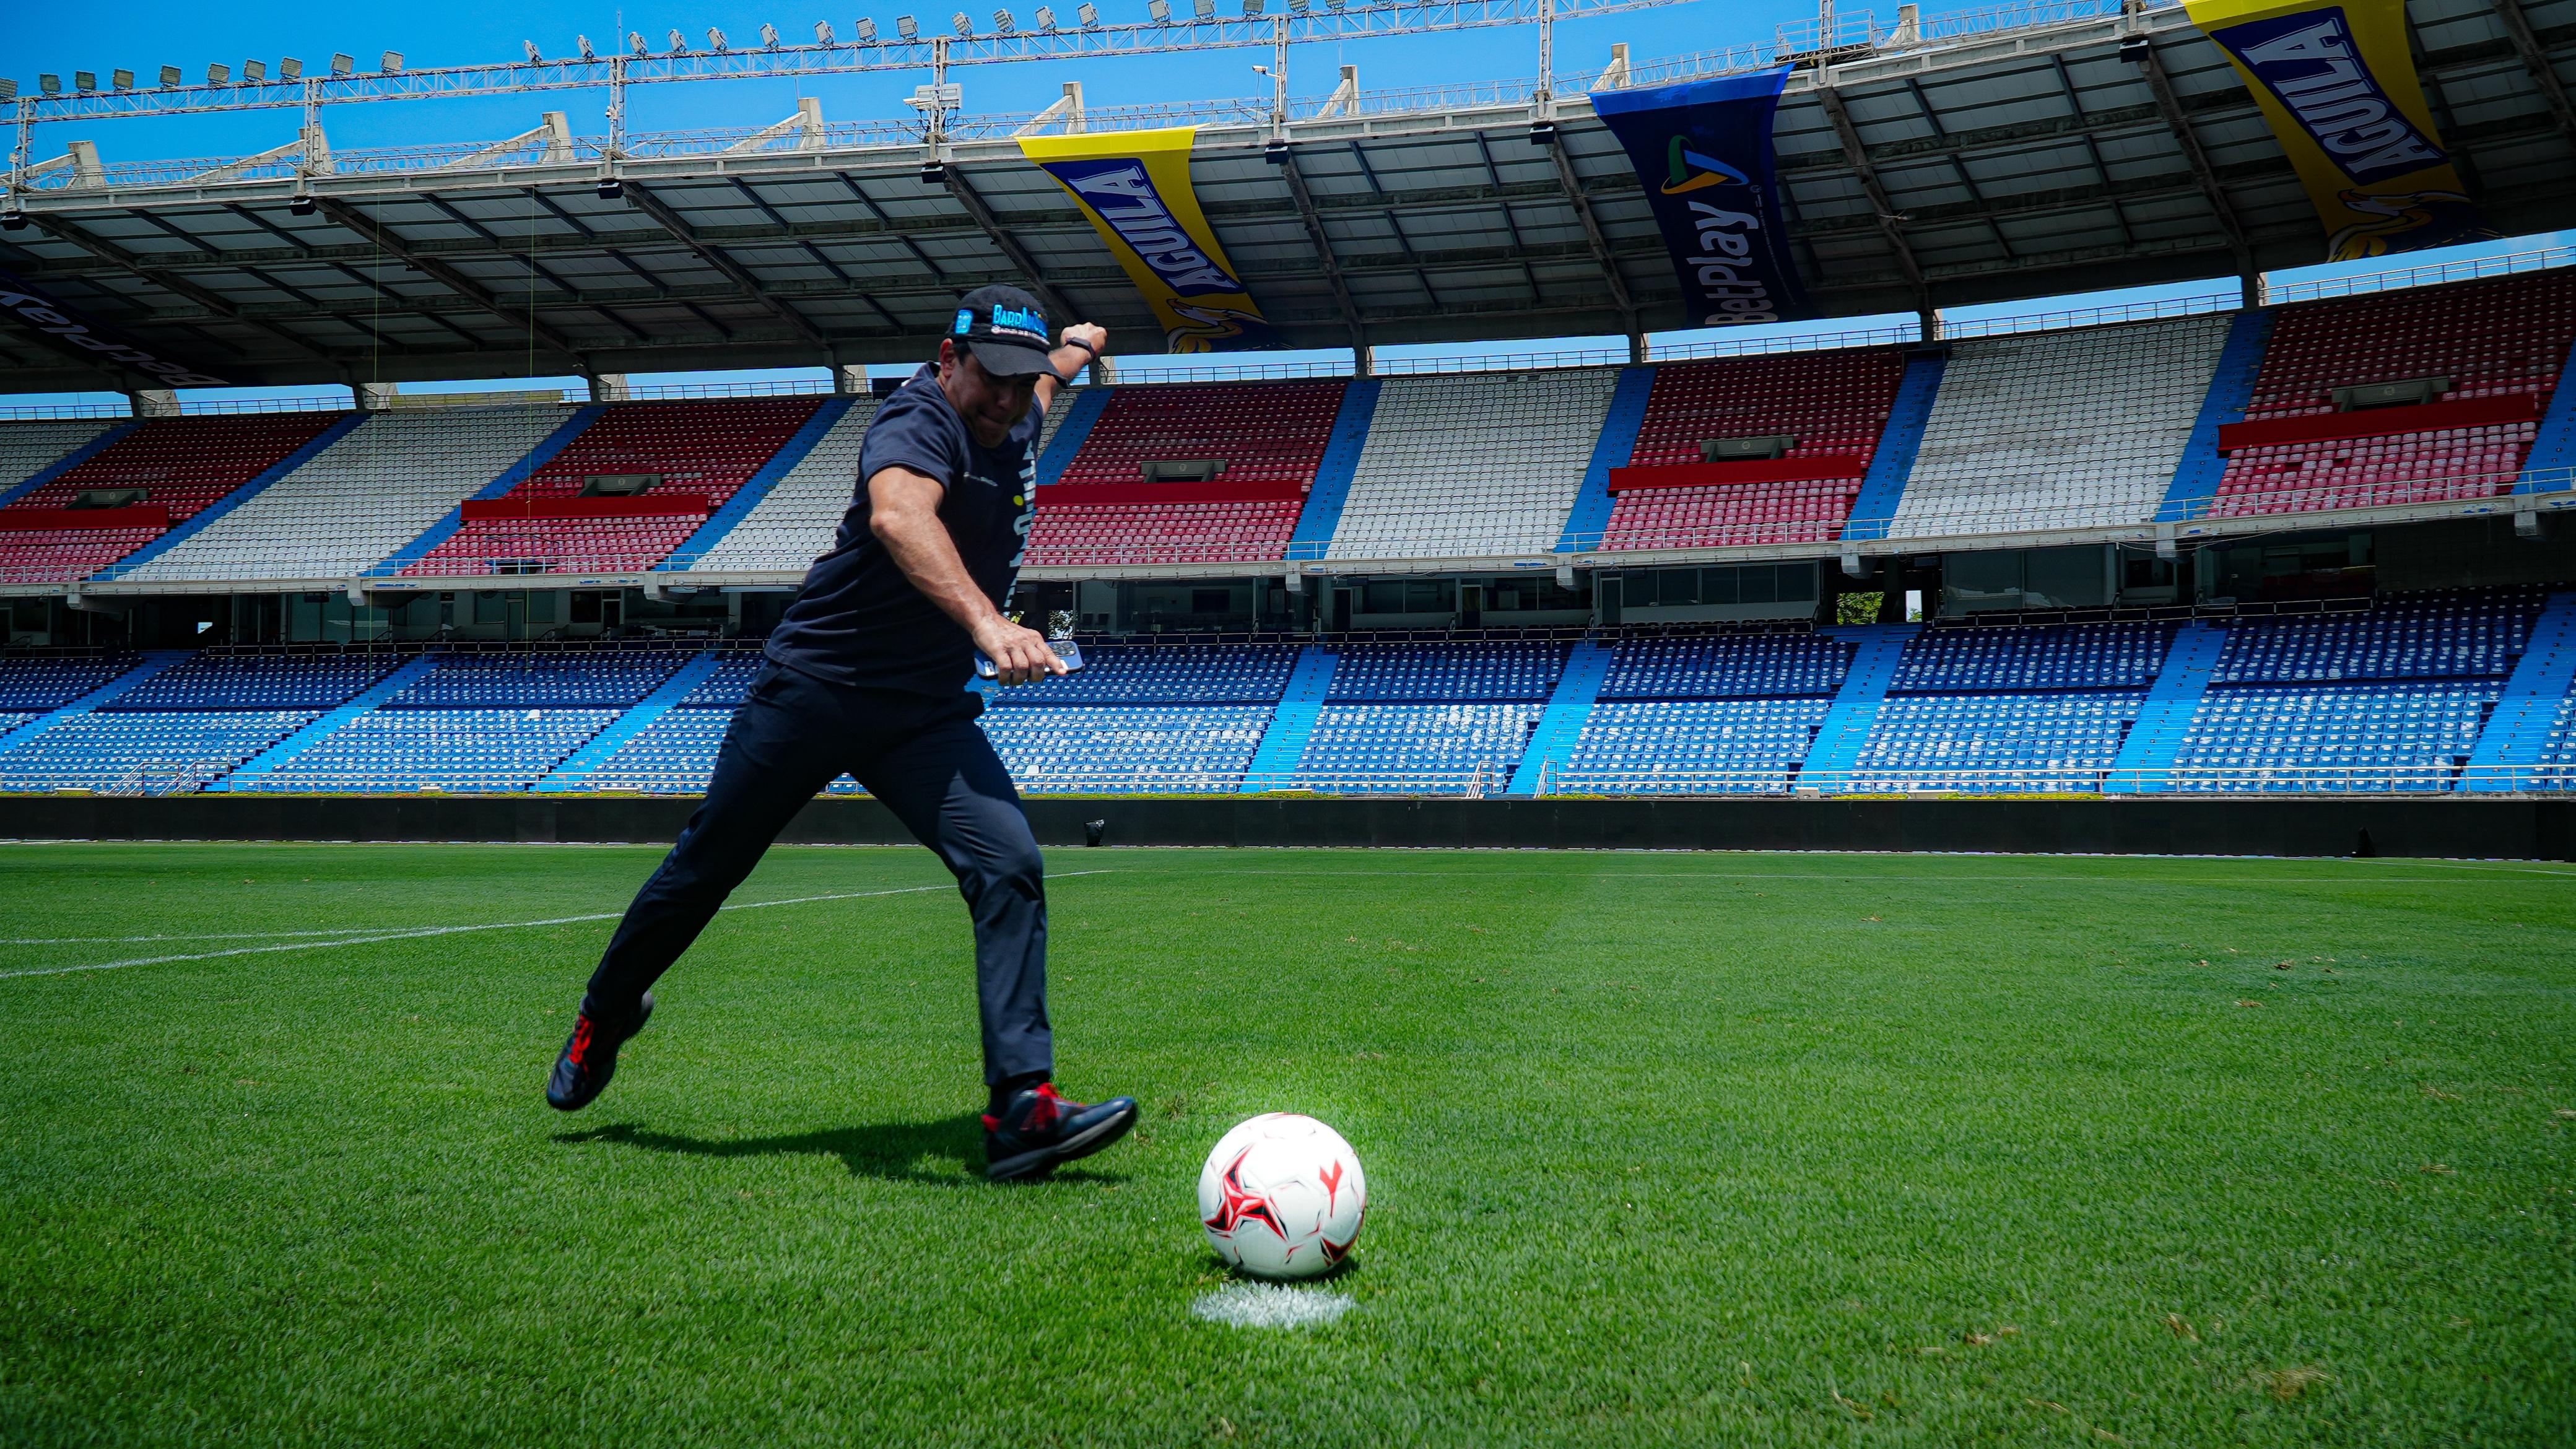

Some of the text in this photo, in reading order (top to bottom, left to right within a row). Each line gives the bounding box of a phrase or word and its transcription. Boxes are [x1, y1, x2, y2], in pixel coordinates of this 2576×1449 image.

[2240, 17, 2442, 174] AGUILA
[1068, 165, 1239, 289] AGUILA
[1687, 201, 1778, 324] BetPlay
